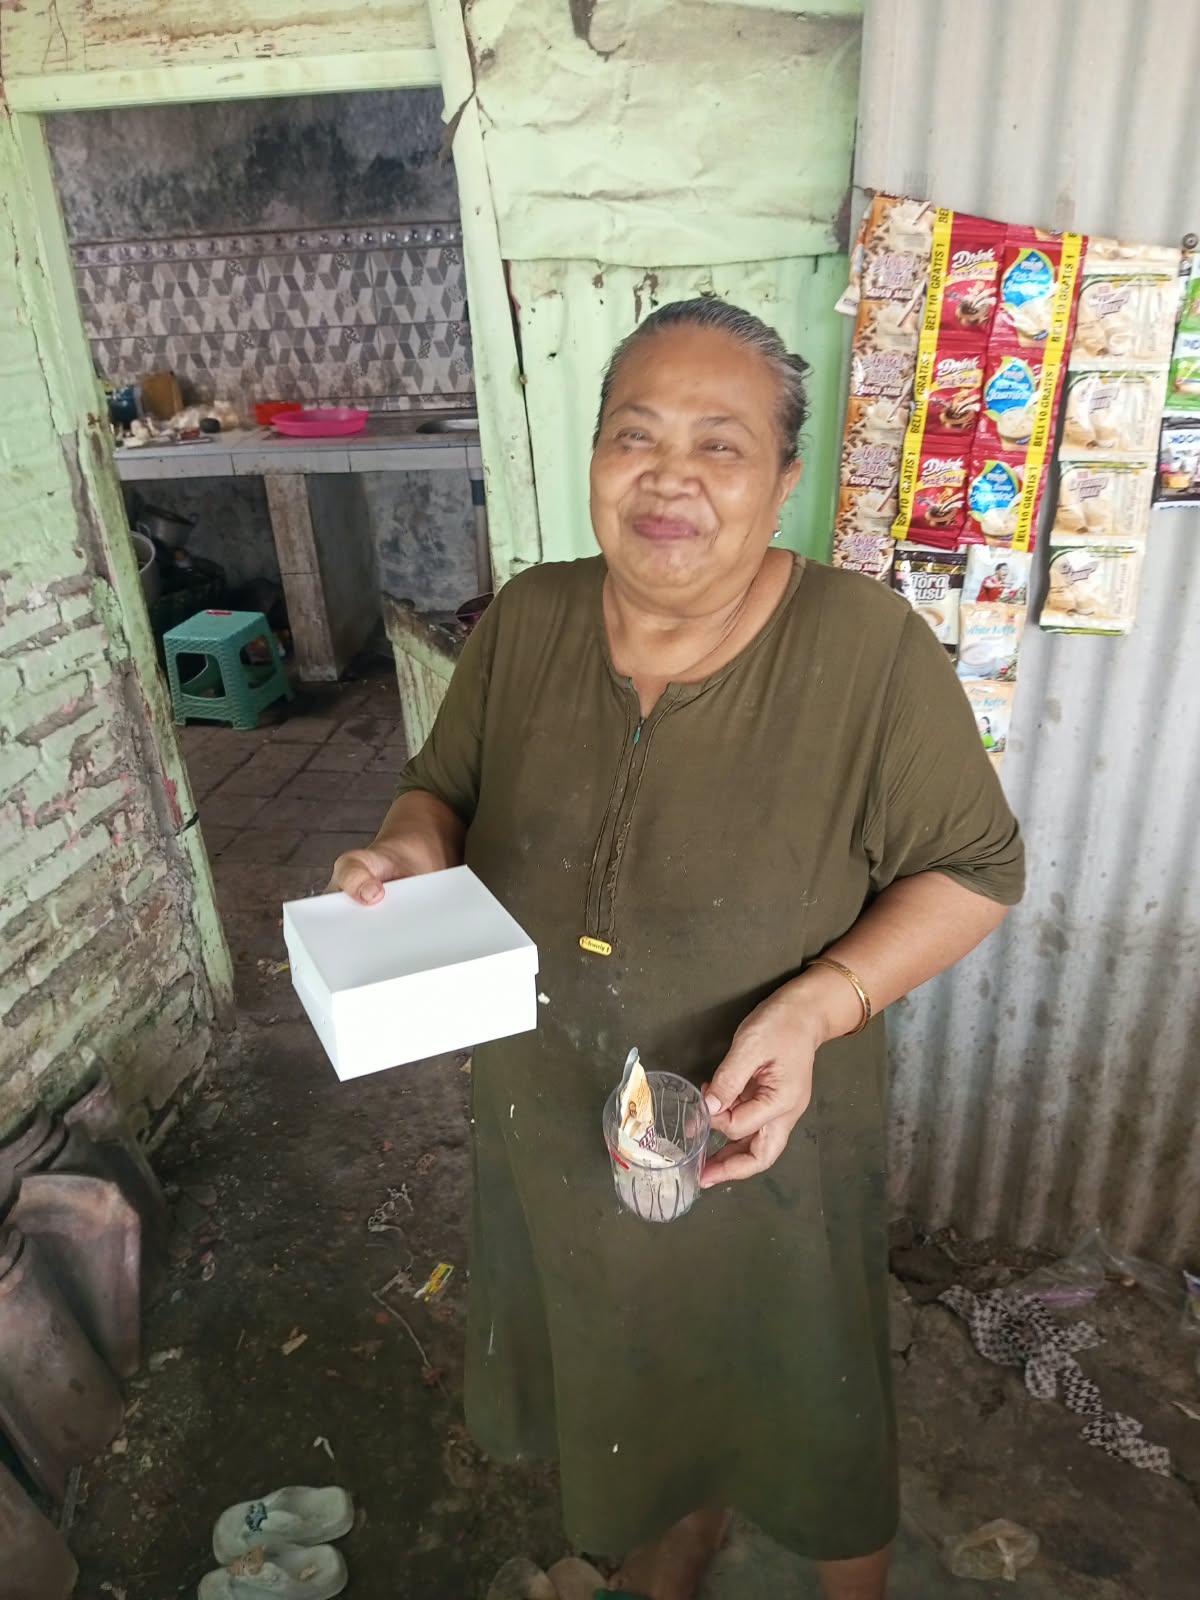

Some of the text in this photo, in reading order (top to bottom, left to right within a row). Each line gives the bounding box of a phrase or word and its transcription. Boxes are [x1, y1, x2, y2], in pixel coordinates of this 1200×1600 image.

[931, 250, 945, 289] GRATIS
[951, 247, 996, 270] Drink
[930, 294, 939, 306] 10
[924, 308, 937, 331] BELI
[936, 355, 980, 375] Drink
[915, 361, 930, 396] GRATIS
[1043, 371, 1056, 409] GRATIS
[1039, 410, 1048, 423] 10
[1033, 425, 1045, 447] BELI
[903, 458, 915, 493] GRATIS
[921, 457, 964, 476] Drink
[1023, 474, 1037, 509] GRATIS
[1020, 510, 1029, 522] 10
[913, 573, 949, 589] Tora
